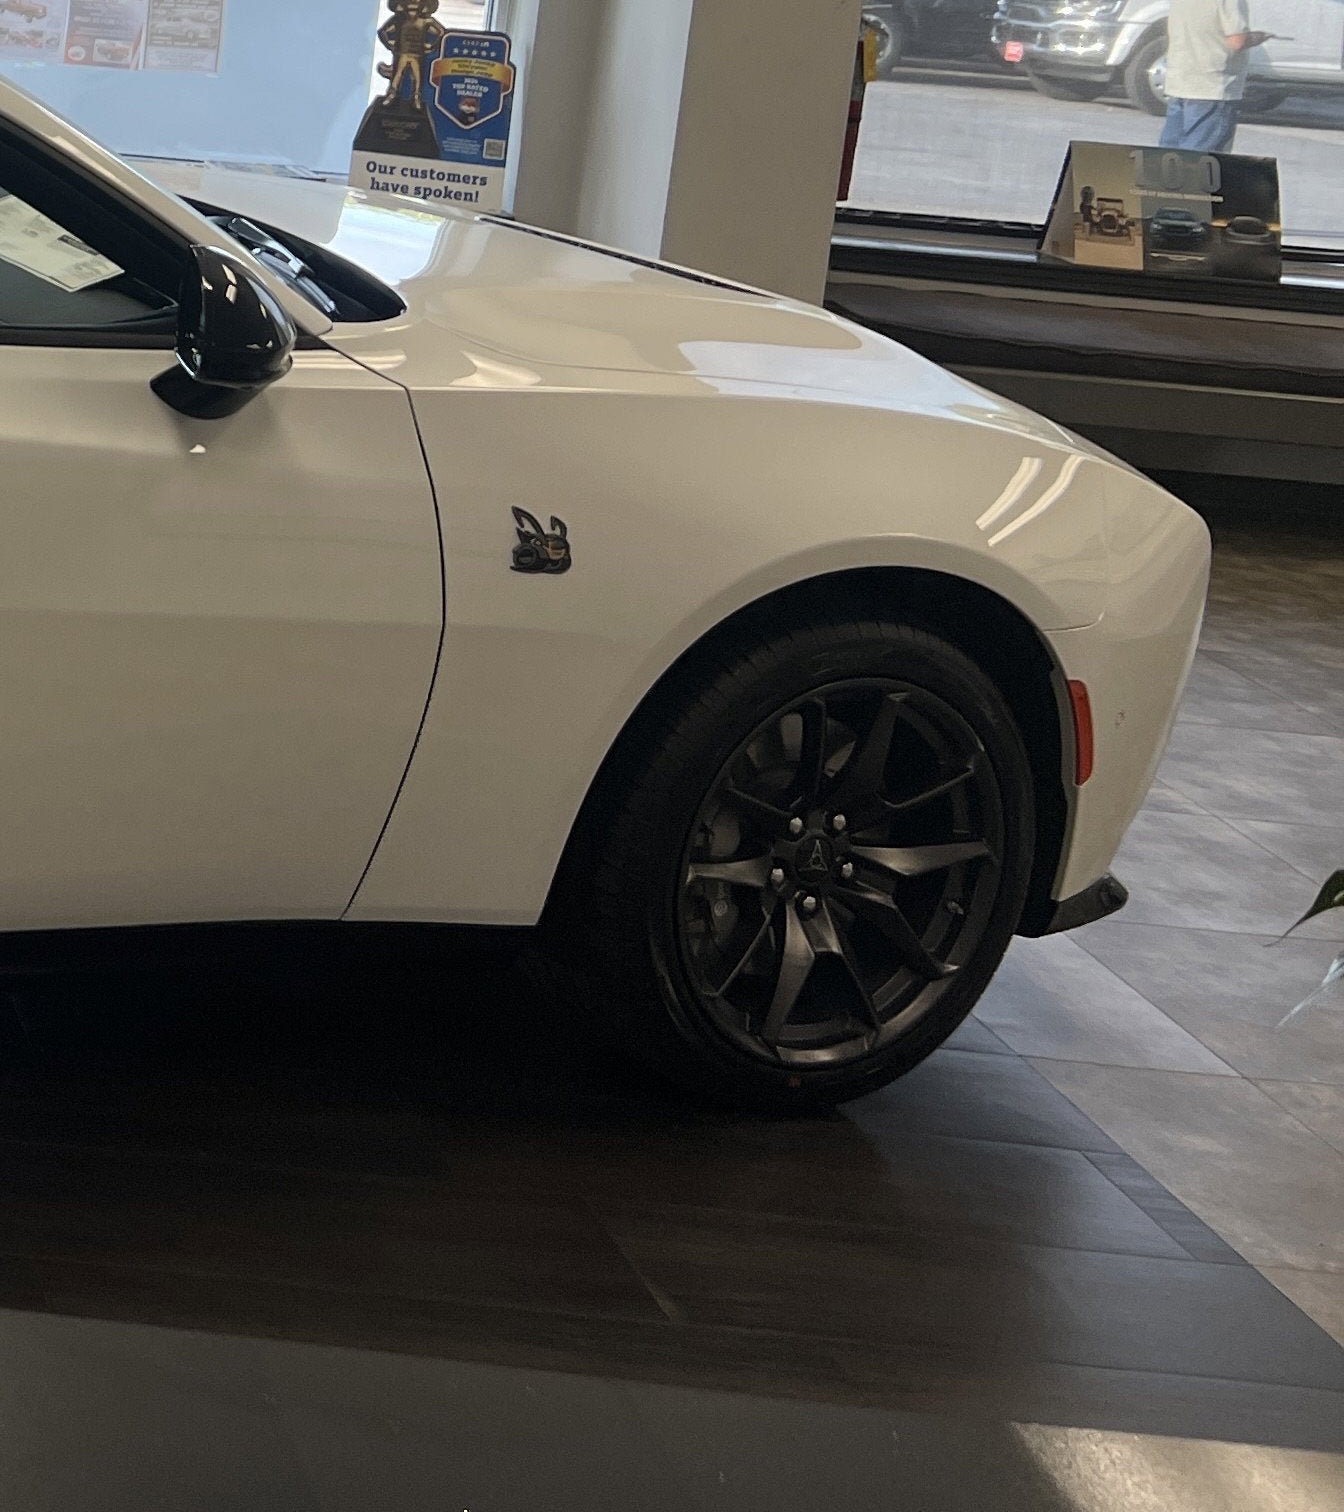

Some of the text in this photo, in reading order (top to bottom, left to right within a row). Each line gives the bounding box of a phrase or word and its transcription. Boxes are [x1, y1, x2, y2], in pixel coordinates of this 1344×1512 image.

[366, 160, 489, 187] Our customers
[369, 177, 480, 203] have spoken!
